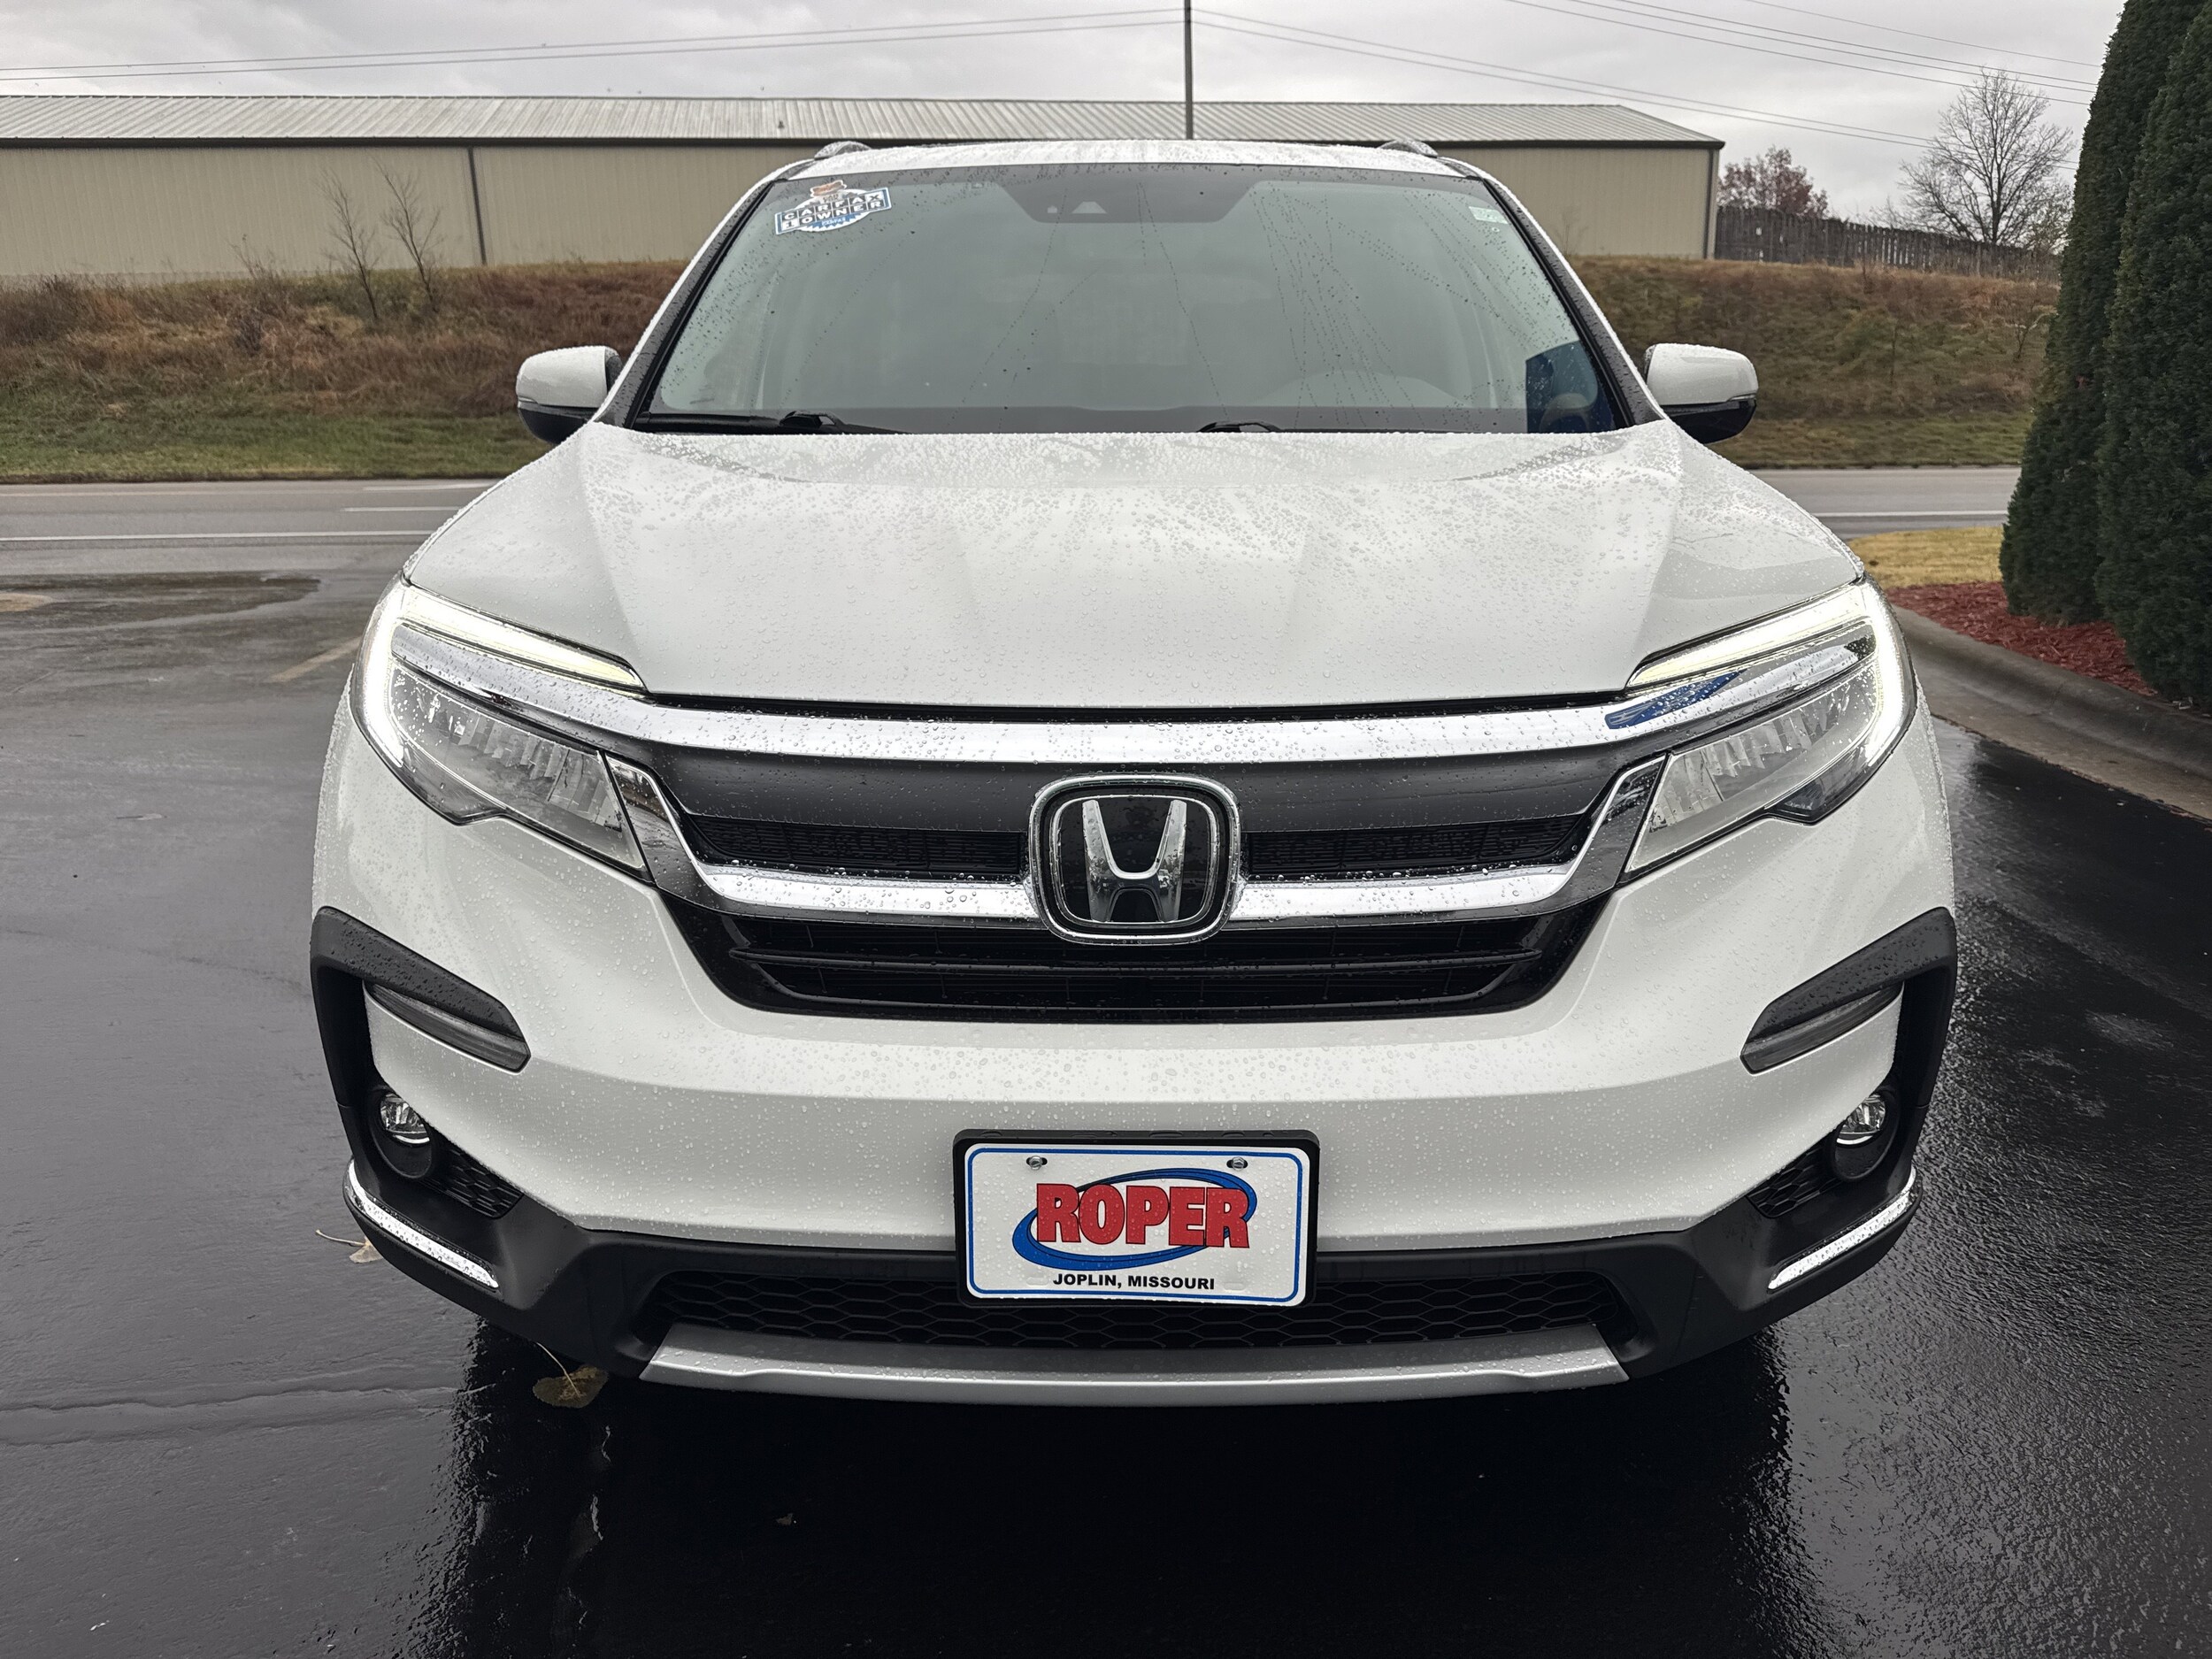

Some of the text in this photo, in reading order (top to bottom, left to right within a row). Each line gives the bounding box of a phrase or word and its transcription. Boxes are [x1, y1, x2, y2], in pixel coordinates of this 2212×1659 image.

[784, 194, 879, 219] CARFAX
[802, 201, 881, 224] OWNER
[1036, 1183, 1250, 1248] ROPER
[1053, 1273, 1215, 1290] JOPLIN, MISSOURI
